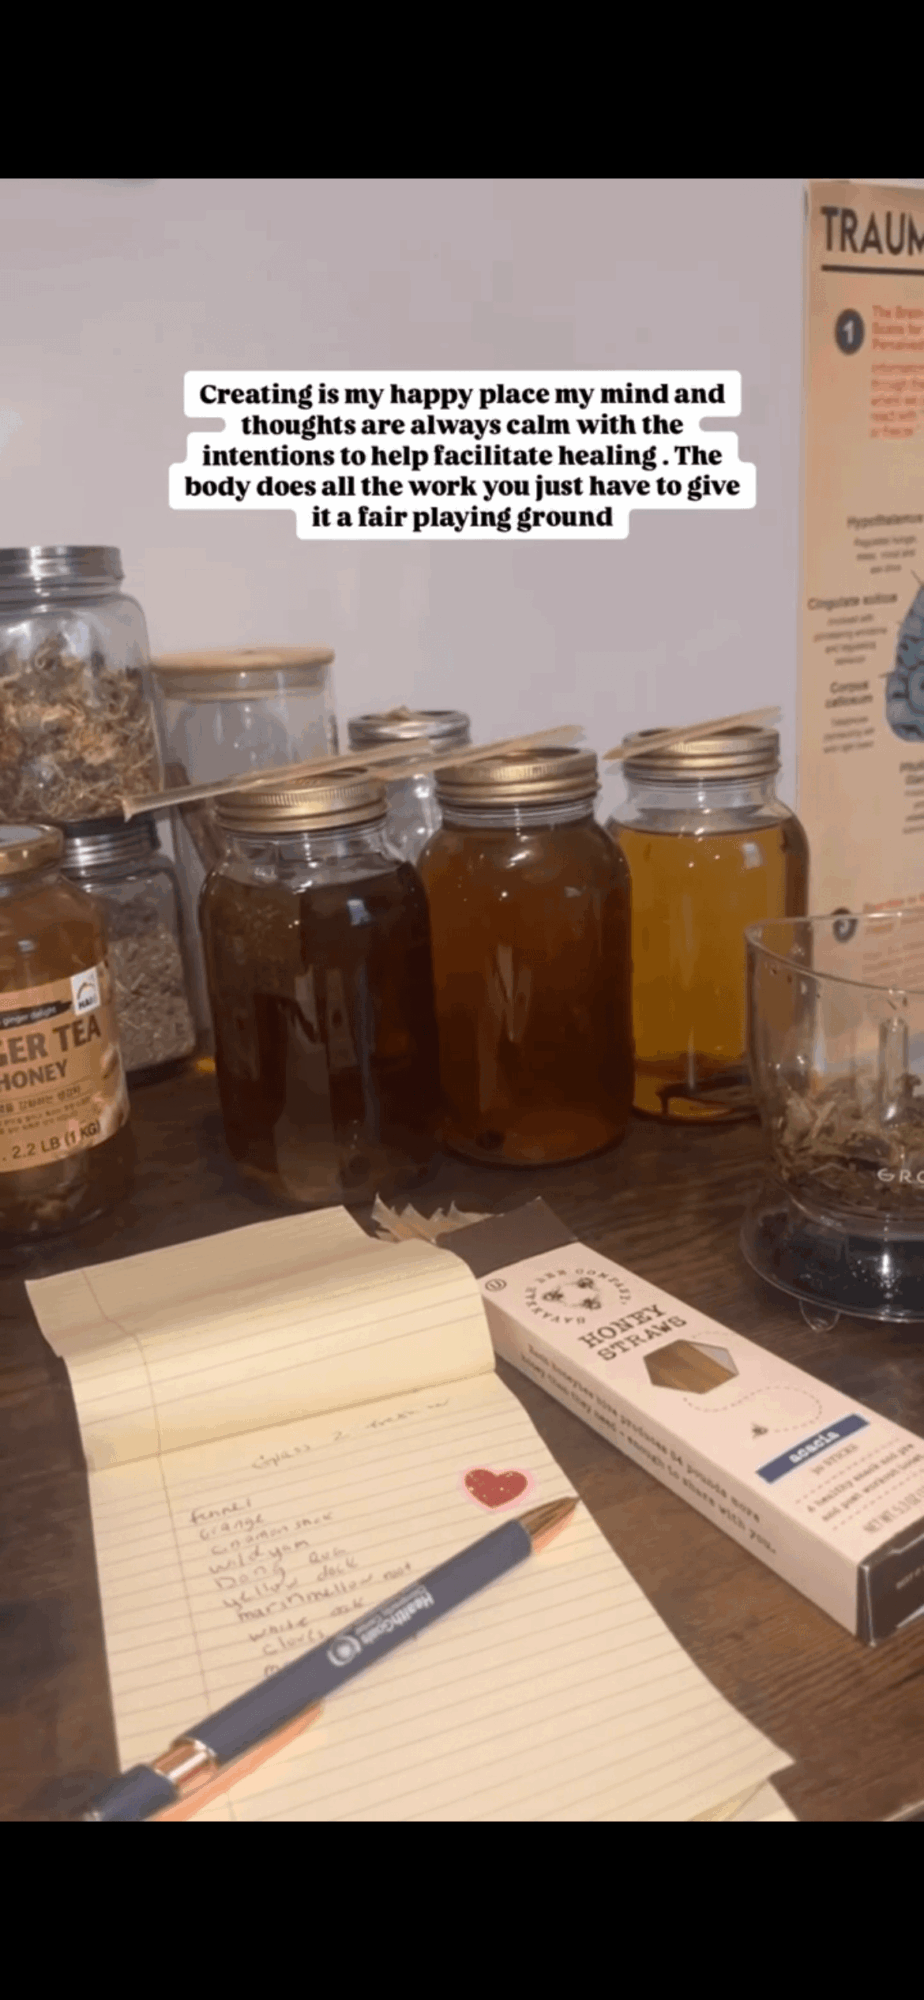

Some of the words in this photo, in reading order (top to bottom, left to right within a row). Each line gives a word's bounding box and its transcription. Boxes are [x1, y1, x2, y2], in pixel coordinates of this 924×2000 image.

[52, 1014, 102, 1052] TEA
[0, 1058, 67, 1092] HONEY
[41, 1136, 61, 1153] LB
[578, 1303, 667, 1349] HONEY
[597, 1315, 688, 1361] STRAWS
[789, 1430, 840, 1464] acacia
